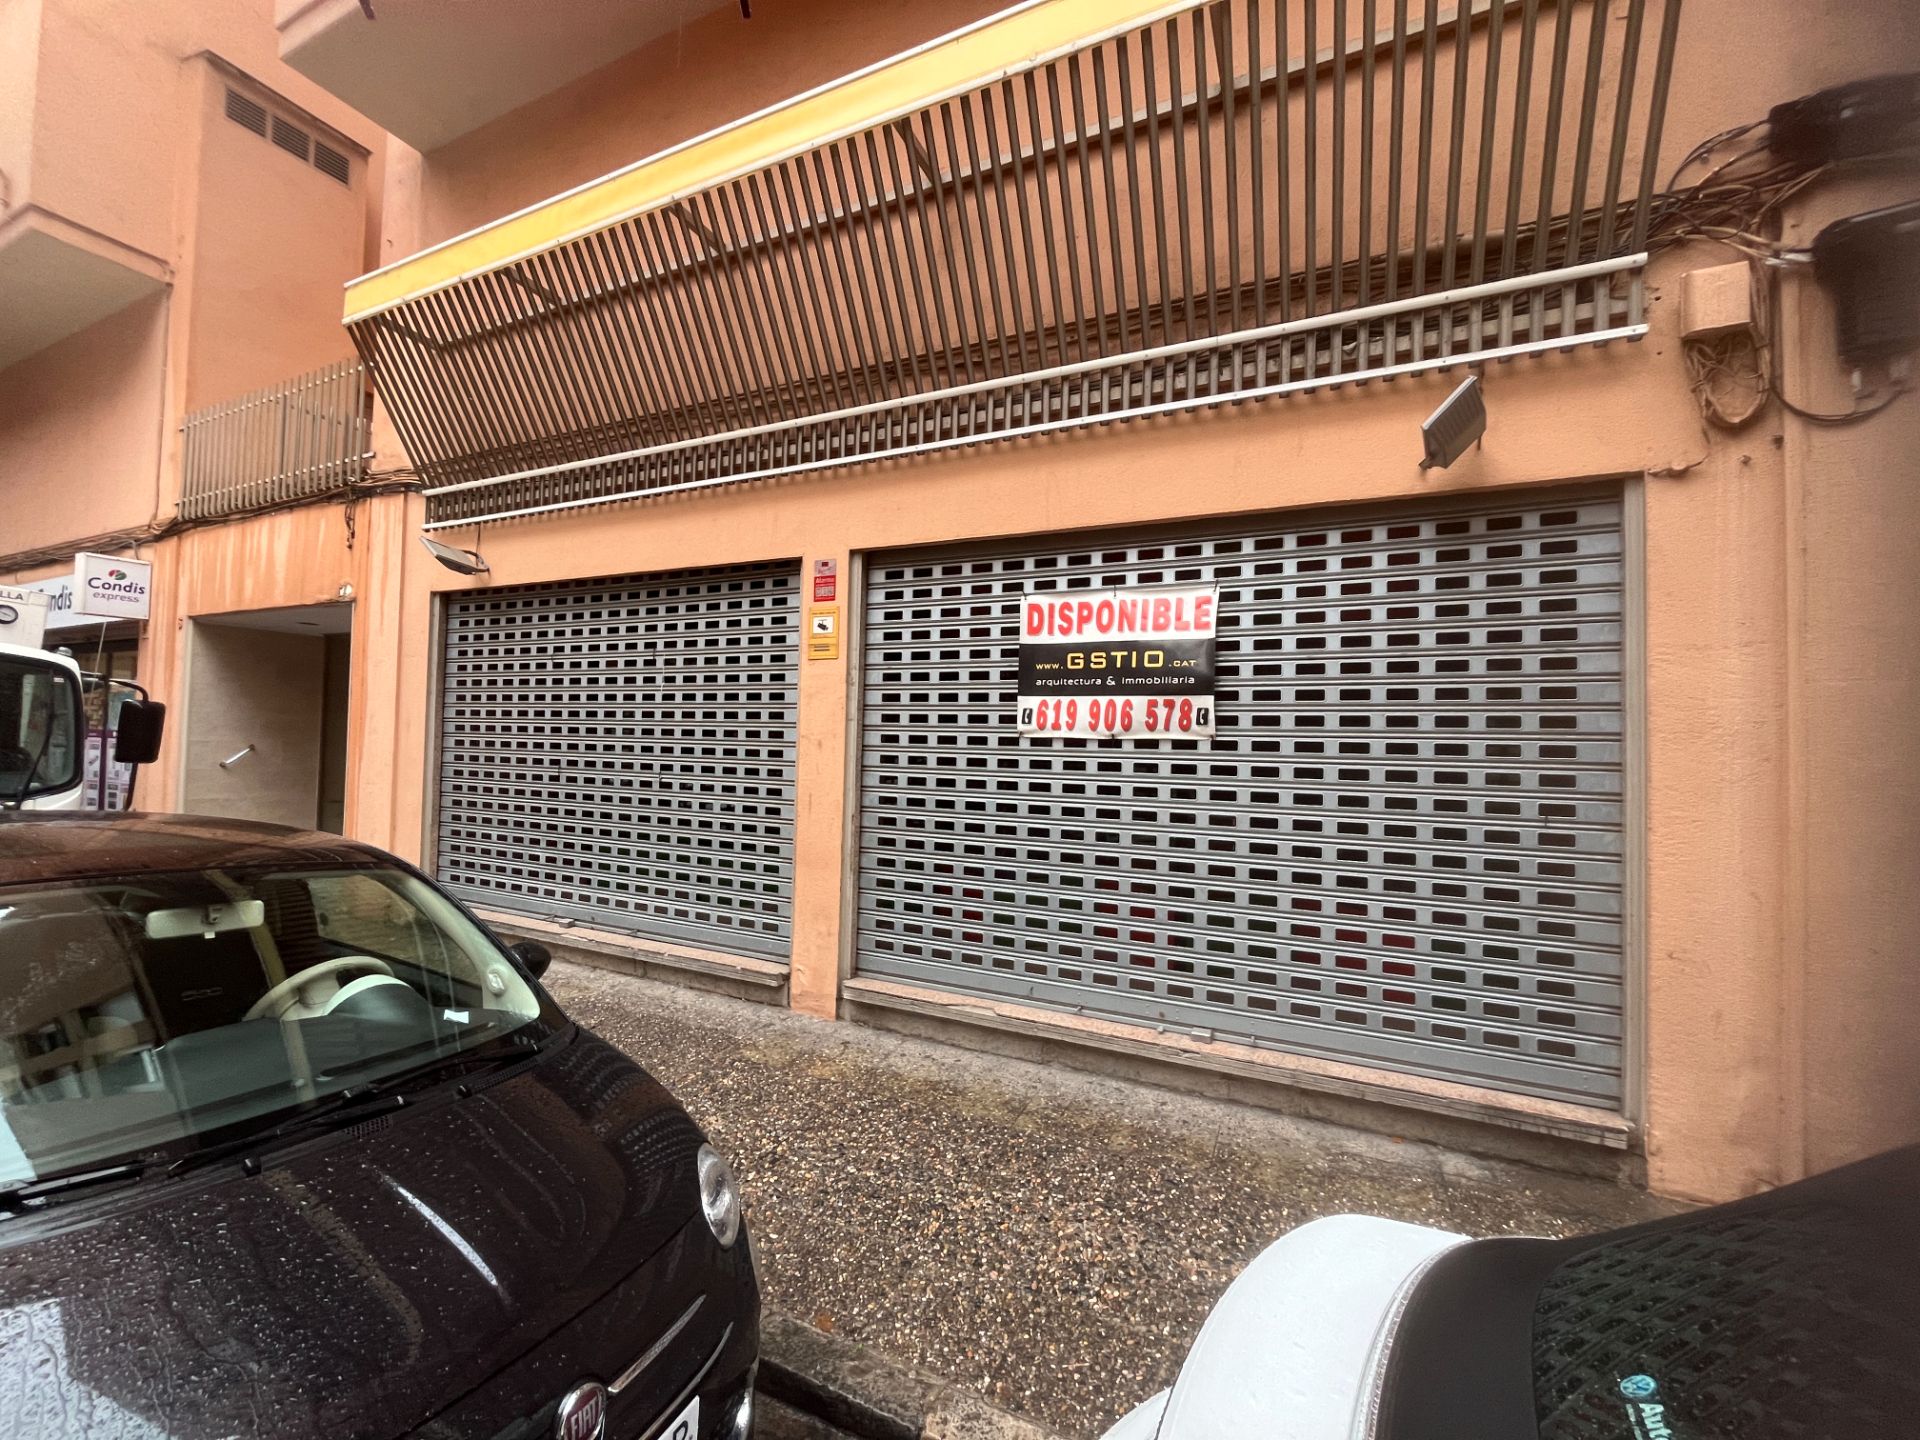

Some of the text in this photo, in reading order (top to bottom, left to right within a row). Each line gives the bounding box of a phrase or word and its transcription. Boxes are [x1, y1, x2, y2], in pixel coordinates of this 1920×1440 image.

[88, 577, 145, 595] Condis
[93, 590, 139, 603] express
[1026, 596, 1212, 636] DISPONIBLE
[1035, 676, 1195, 687] arquitectura & immobiliaria
[1036, 698, 1193, 732] 619 906 578
[570, 1395, 598, 1440] FIAT
[1638, 1403, 1673, 1440] Aut
